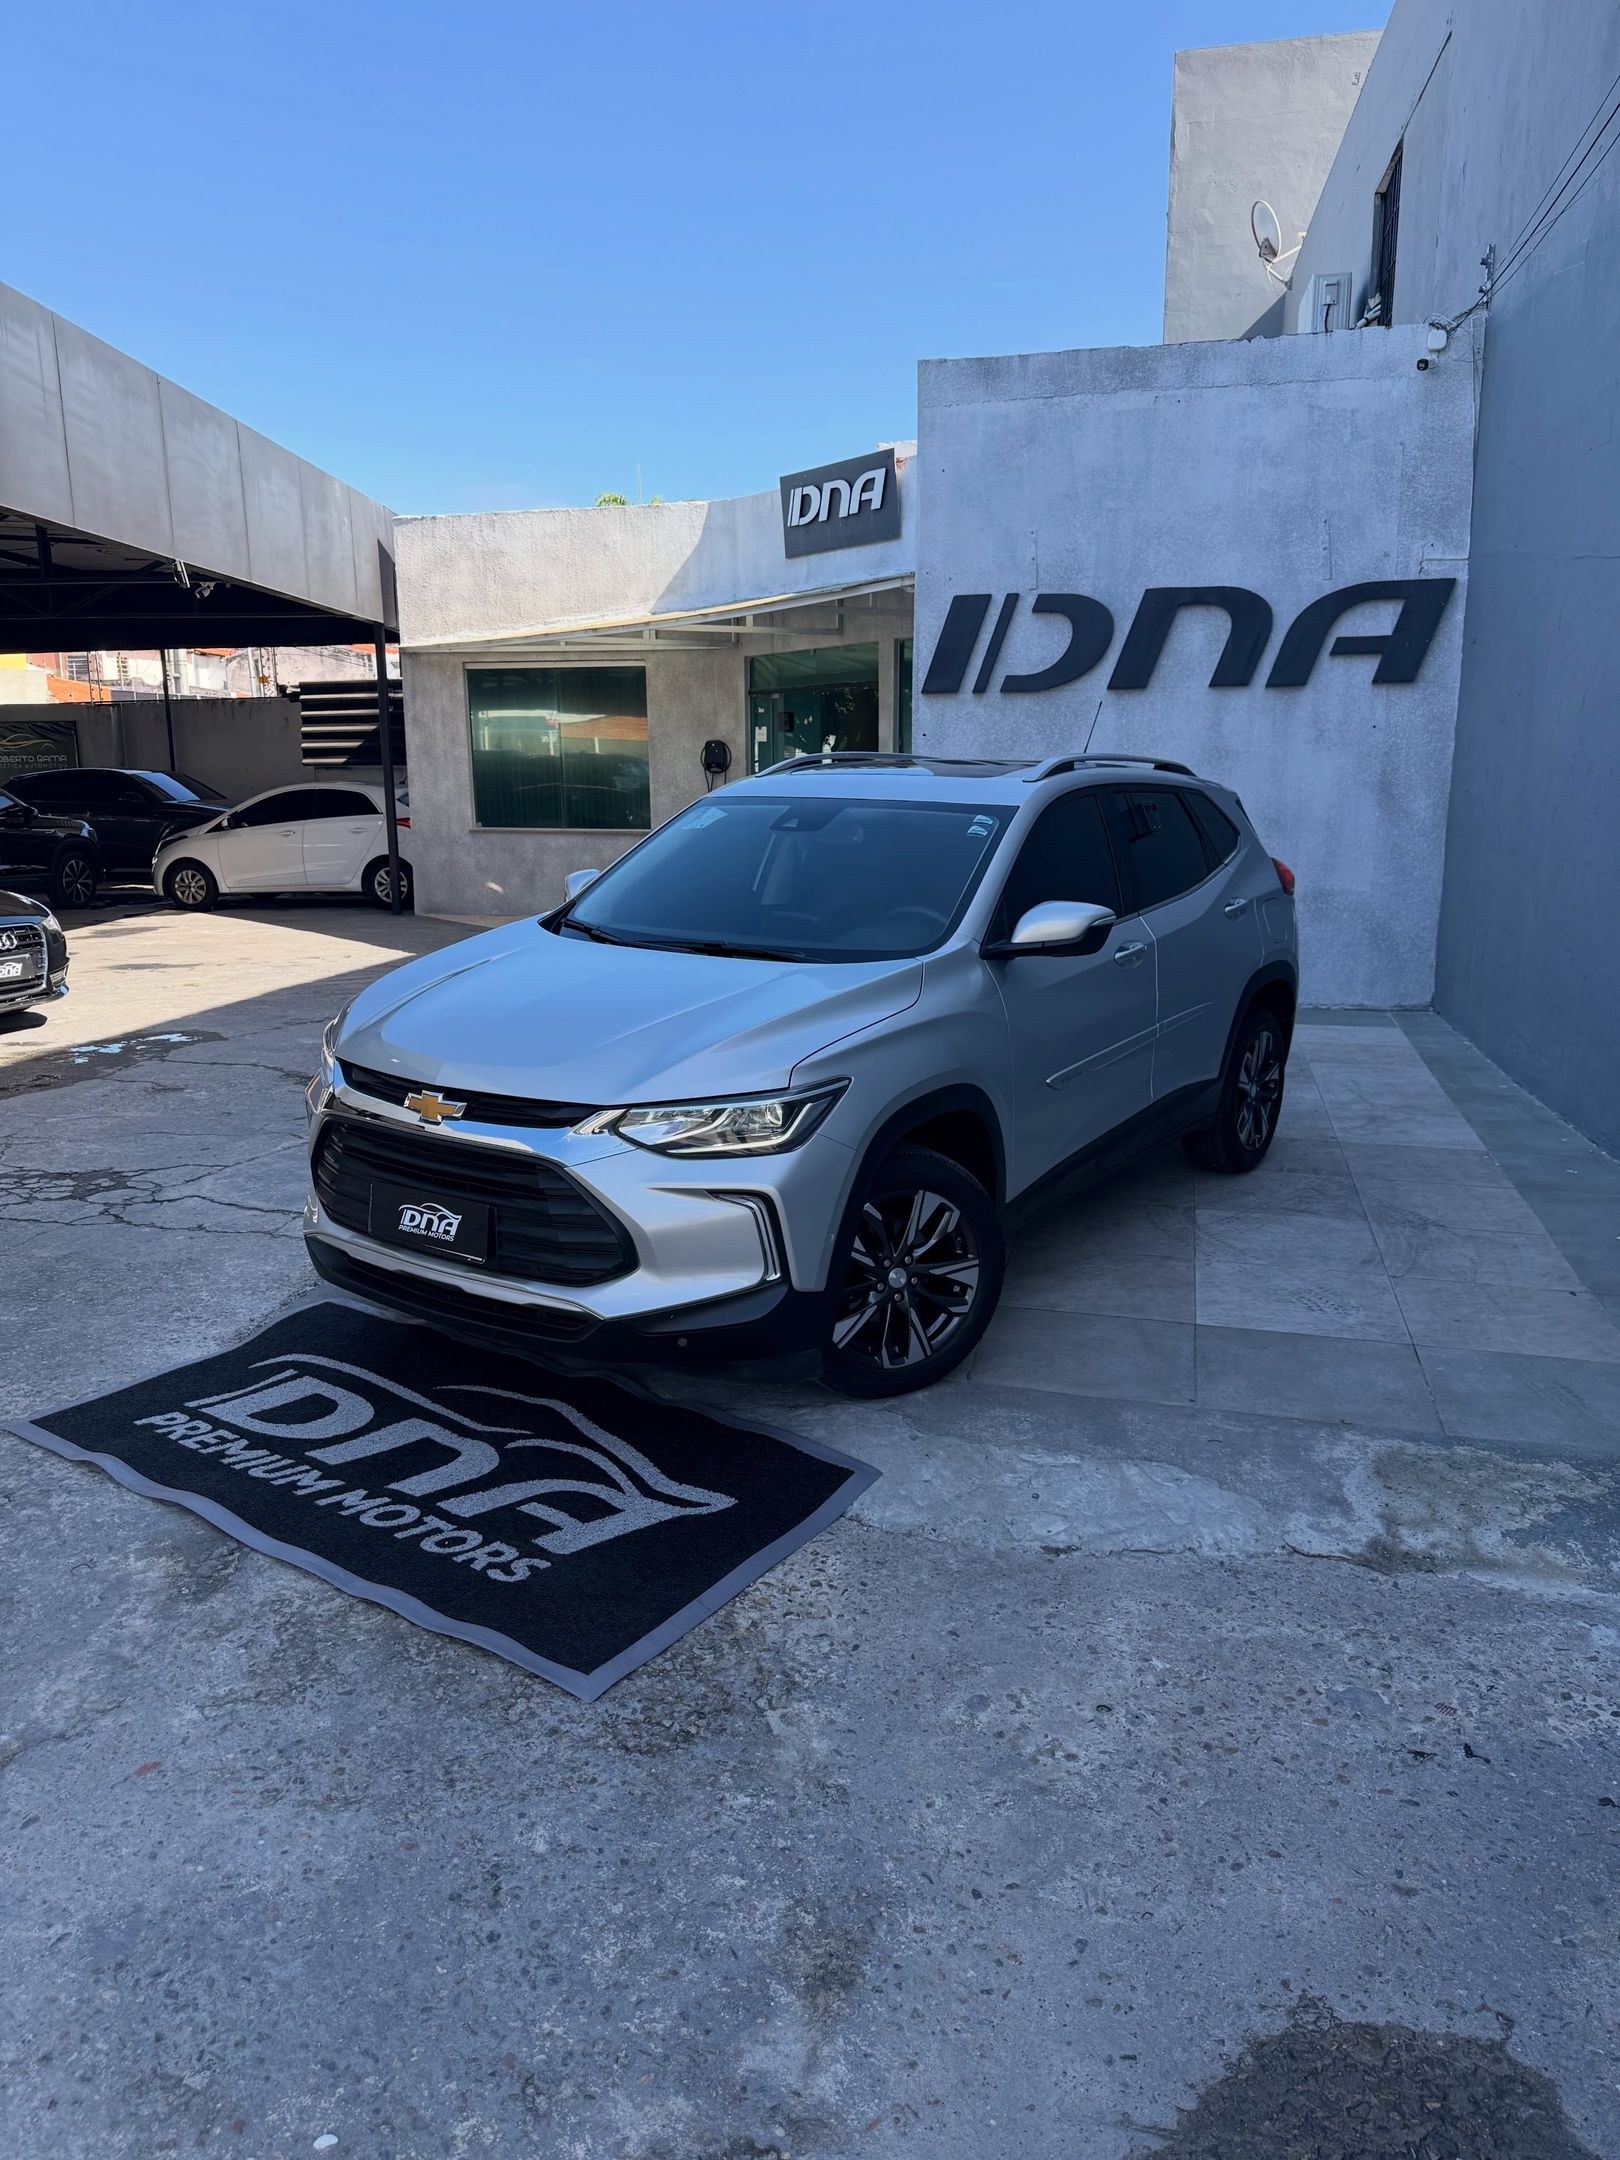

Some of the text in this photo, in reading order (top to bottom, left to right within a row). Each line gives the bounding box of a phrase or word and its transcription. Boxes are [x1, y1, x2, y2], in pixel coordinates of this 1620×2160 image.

[787, 467, 886, 527] DNA
[920, 578, 1457, 694] DNA
[398, 1224, 455, 1242] PREMIUM MOTORS
[400, 1208, 460, 1236] DNA
[133, 1411, 552, 1583] PREMIUM MOTORS
[184, 1368, 675, 1555] DNA
